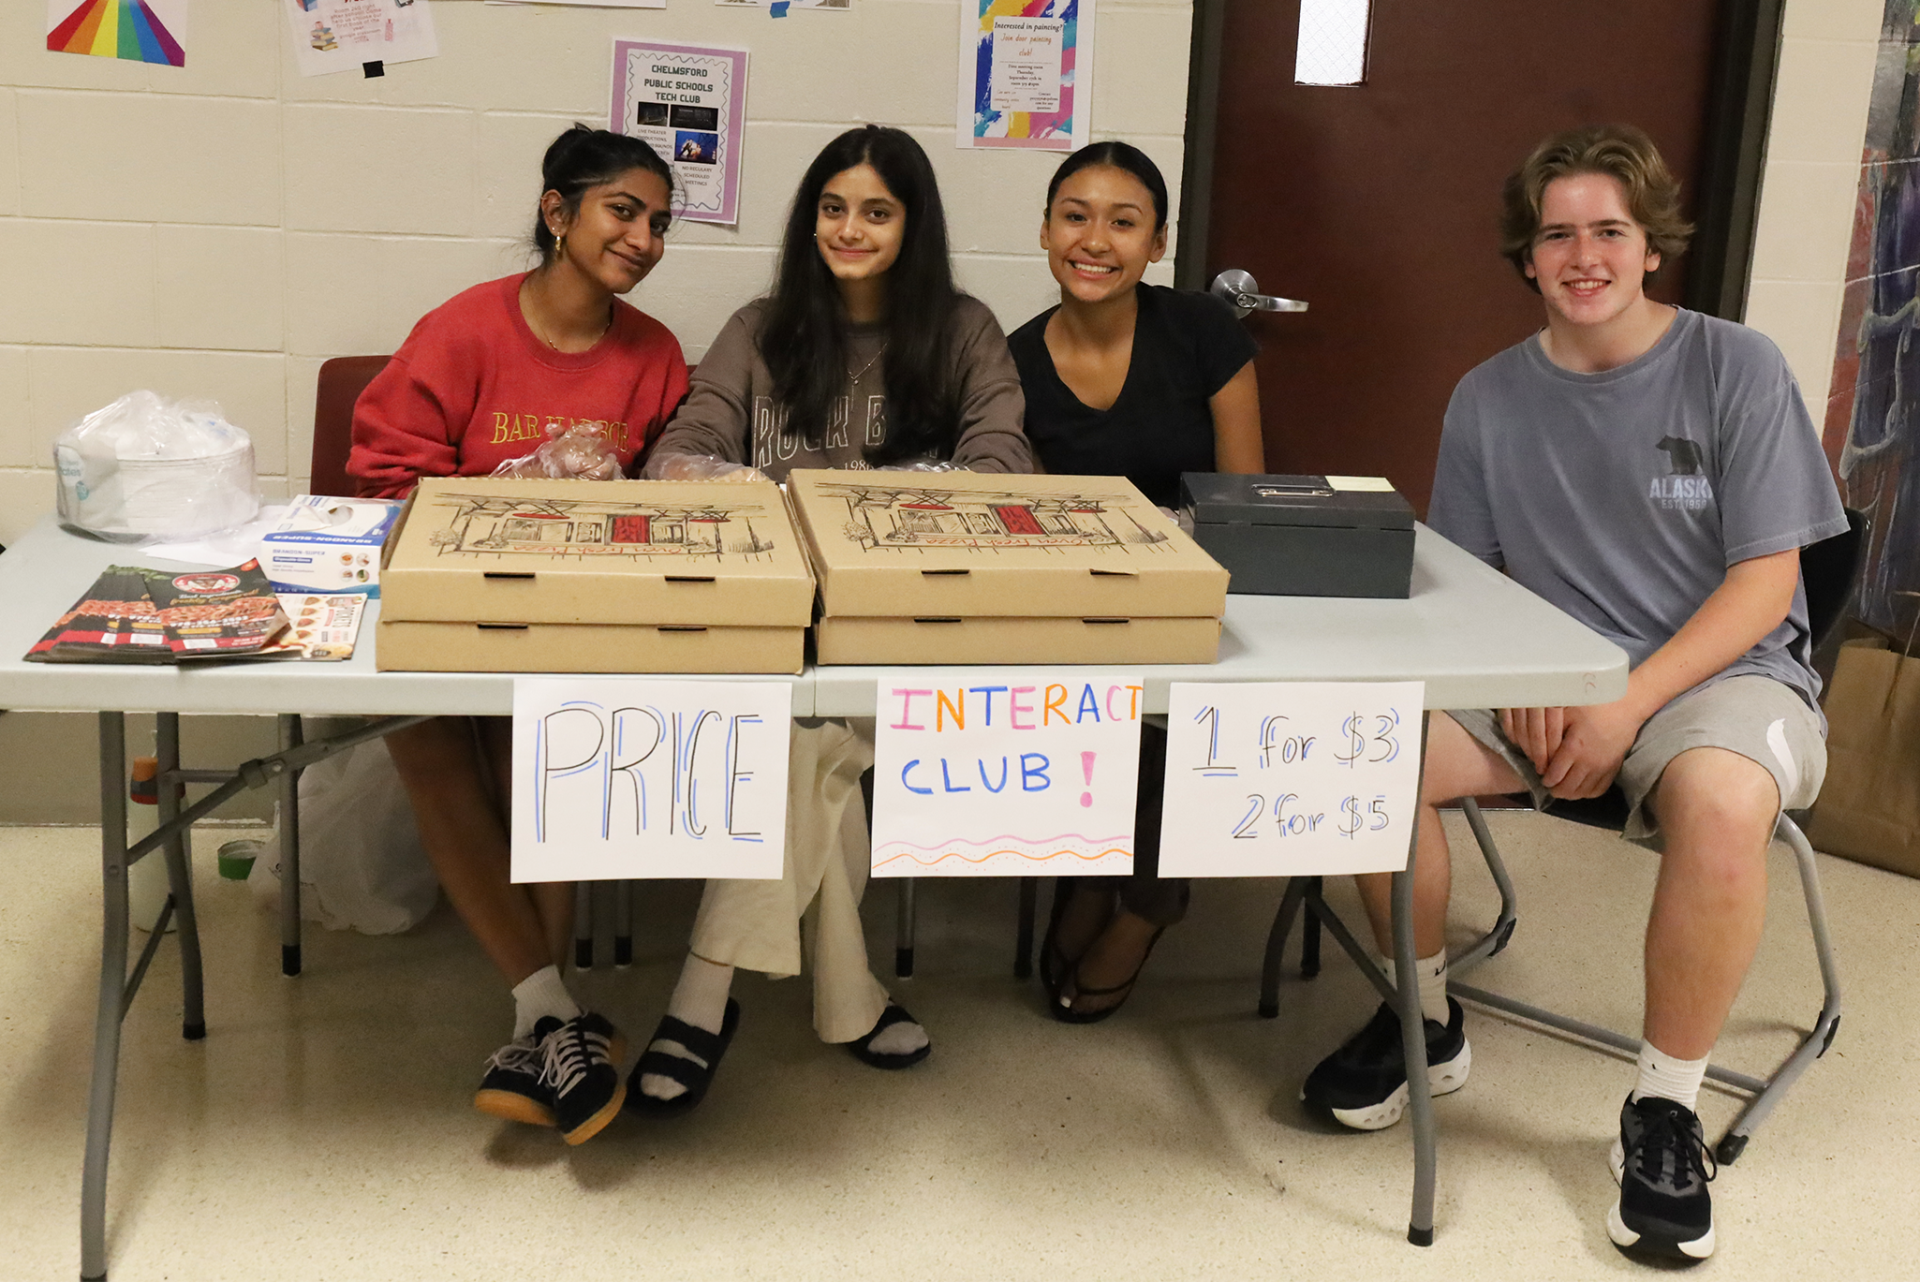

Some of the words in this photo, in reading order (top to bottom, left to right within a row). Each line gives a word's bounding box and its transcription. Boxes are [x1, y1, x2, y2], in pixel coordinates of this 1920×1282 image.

[994, 22, 1025, 30] Interested
[1026, 22, 1032, 30] in
[1033, 23, 1063, 33] painting?
[644, 78, 673, 89] PUBLIC
[675, 81, 713, 92] SCHOOLS
[651, 65, 708, 77] CHELMSFORD
[655, 92, 677, 102] TECH
[680, 94, 701, 104] CLUB
[490, 412, 541, 444] BAR
[546, 415, 629, 452] BOR
[890, 683, 1144, 732] INTERACT
[1193, 706, 1238, 777] 1
[1259, 715, 1317, 769] for
[1334, 707, 1399, 769] $3
[535, 700, 764, 843] PRICE
[1231, 794, 1265, 839] 2
[1274, 793, 1325, 838] for
[1338, 795, 1389, 840] $5
